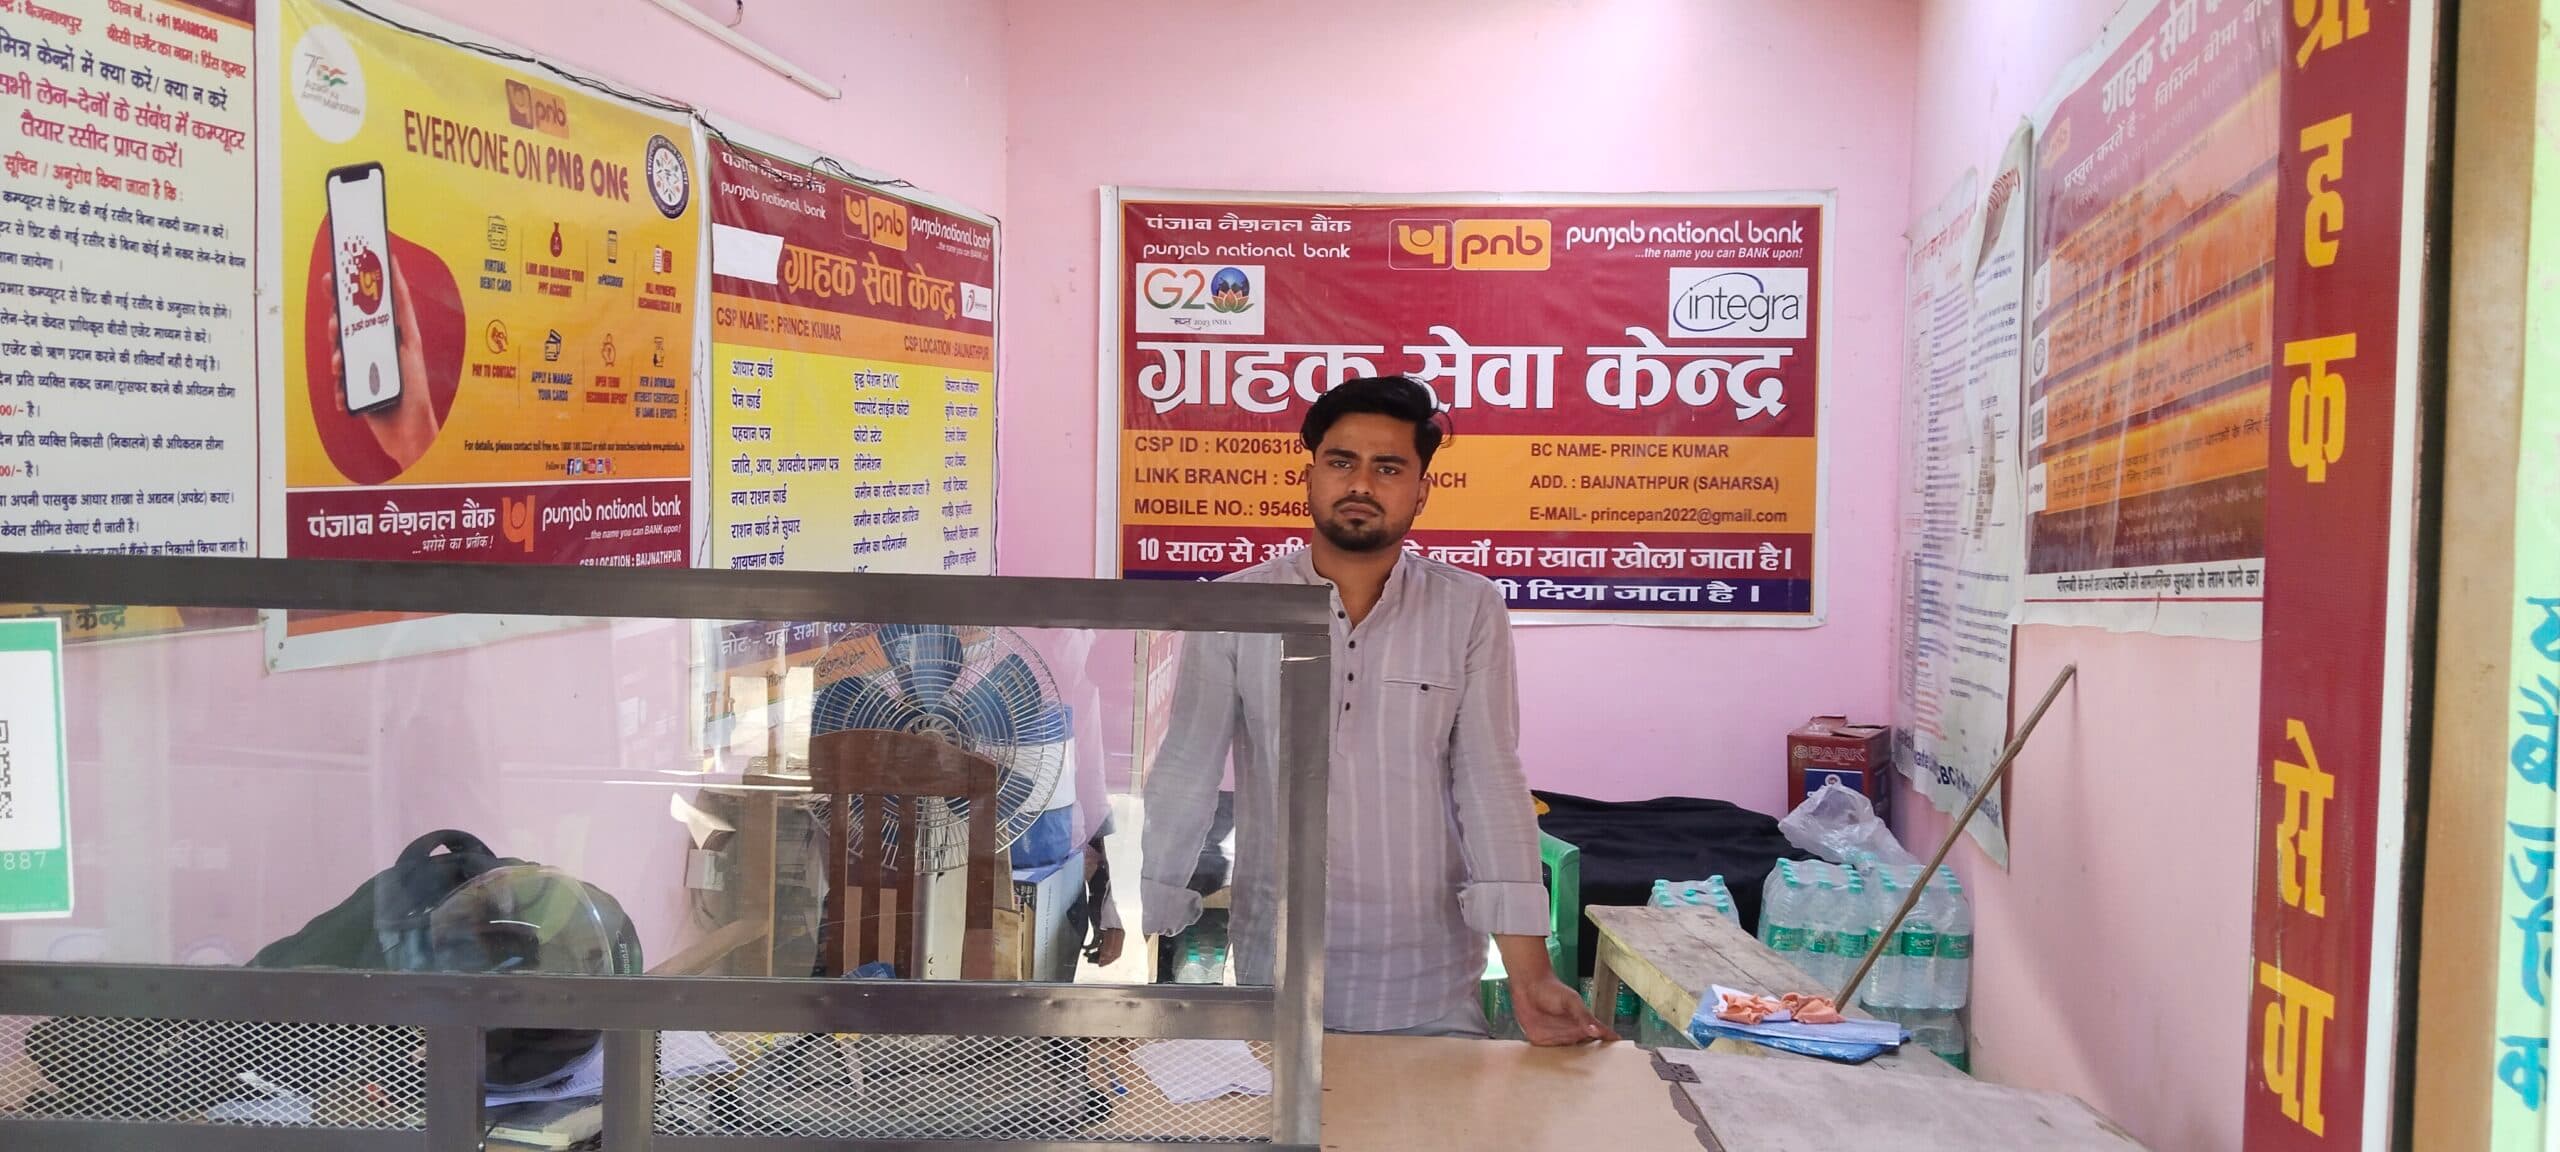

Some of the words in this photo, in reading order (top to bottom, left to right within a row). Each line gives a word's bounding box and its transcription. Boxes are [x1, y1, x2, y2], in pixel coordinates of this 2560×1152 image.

[36, 38, 75, 72] केन्द्रों
[80, 49, 94, 77] में
[99, 61, 126, 85] क्या
[164, 78, 188, 101] क्या
[192, 86, 204, 104] न
[207, 86, 228, 111] करें
[2102, 36, 2155, 124] ग्राहक
[113, 97, 130, 122] के
[135, 101, 171, 132] संबंध
[175, 111, 188, 137] में
[192, 119, 246, 154] कम्प्यूटर
[535, 102, 567, 134] pnb
[20, 108, 64, 144] तैयार
[68, 121, 109, 152] रसीद
[113, 134, 148, 162] प्राप्त
[403, 109, 510, 175] EVERYONE
[514, 140, 542, 183] ON
[546, 147, 585, 192] PNB
[590, 160, 630, 202] ONE
[53, 162, 92, 190] अनुरोध
[95, 166, 122, 192] किया
[722, 182, 760, 202] punjab
[761, 193, 802, 213] national
[804, 200, 827, 219] bank
[872, 211, 904, 240] pnb
[911, 215, 939, 240] punjab
[939, 219, 972, 243] national
[972, 228, 990, 249] bank
[1145, 216, 1211, 231] पंजाब
[1218, 211, 1303, 233] नैशनल
[1310, 213, 1352, 233] बैंक
[1566, 220, 1645, 250] punjab
[1649, 220, 1741, 244] national
[1748, 220, 1804, 244] bank
[1143, 241, 1209, 259] punjab
[1216, 241, 1295, 258] national
[1304, 241, 1351, 258] bank
[1461, 225, 1543, 264] pnb
[1663, 249, 1692, 259] name
[1694, 249, 1714, 261] you
[1716, 249, 1736, 258] can
[1738, 247, 1769, 259] BANK
[1772, 247, 1803, 261] upon!
[784, 244, 858, 297] ग्राहक
[862, 252, 903, 307] सेवा
[907, 263, 956, 320] केन्द्र
[1688, 286, 1800, 332] integra
[716, 307, 738, 327] CSP
[740, 310, 769, 331] NAME
[777, 315, 809, 337] PRINCE
[811, 322, 841, 341] KUMAR
[758, 358, 774, 378] कार्ड
[1136, 341, 1385, 415] ग्राहक
[1403, 325, 1563, 411] सेवा
[1585, 326, 1793, 421] केन्द्र
[746, 388, 761, 409] कार्ड
[732, 426, 757, 441] पहचान
[759, 427, 771, 441] पत्र
[1135, 436, 1173, 452] CSP
[1180, 437, 1199, 452] ID
[1531, 443, 1552, 457] BC
[1556, 443, 1607, 458] NAME-
[1610, 443, 1668, 458] PRINCE
[1672, 444, 1729, 458] KUMAR
[1135, 467, 1178, 484] LINK
[1185, 468, 1267, 486] BRANCH
[1427, 472, 1467, 488] NCH
[1530, 475, 1567, 489] ADD.
[1580, 475, 1689, 490] BAIJNATHPUR
[1693, 475, 1780, 493] (SAHARSA)
[731, 491, 747, 505] नया
[750, 490, 771, 505] राशन
[773, 482, 787, 503] कार्ड
[307, 508, 374, 538] पंजाब
[379, 500, 456, 535] नैशनल
[462, 498, 495, 531] बैंक
[542, 499, 592, 531] punjab
[596, 498, 648, 521] national
[652, 495, 681, 517] bank
[1135, 499, 1207, 516] MOBILE
[1259, 500, 1311, 517] 95468
[1530, 506, 1587, 520] E-MAIL-
[1591, 507, 1788, 526] princepan2022@gmail.com
[731, 523, 752, 539] राशन
[754, 515, 770, 536] कार्ड
[449, 537, 462, 550] का
[1138, 537, 1159, 560] 10
[1166, 542, 1227, 562] साल
[1229, 537, 1255, 562] से
[1428, 539, 1491, 567] बच्चों
[1495, 547, 1534, 567] का
[1538, 547, 1606, 568] खाता
[1611, 541, 1687, 569] खोला
[1690, 549, 1755, 570] जाता
[1527, 578, 1605, 601] दिया
[1614, 585, 1702, 602] जाता
[1707, 580, 1737, 603] है
[2228, 566, 2244, 588] पाने
[2246, 569, 2260, 587] का
[1792, 745, 1866, 761] SPARK
